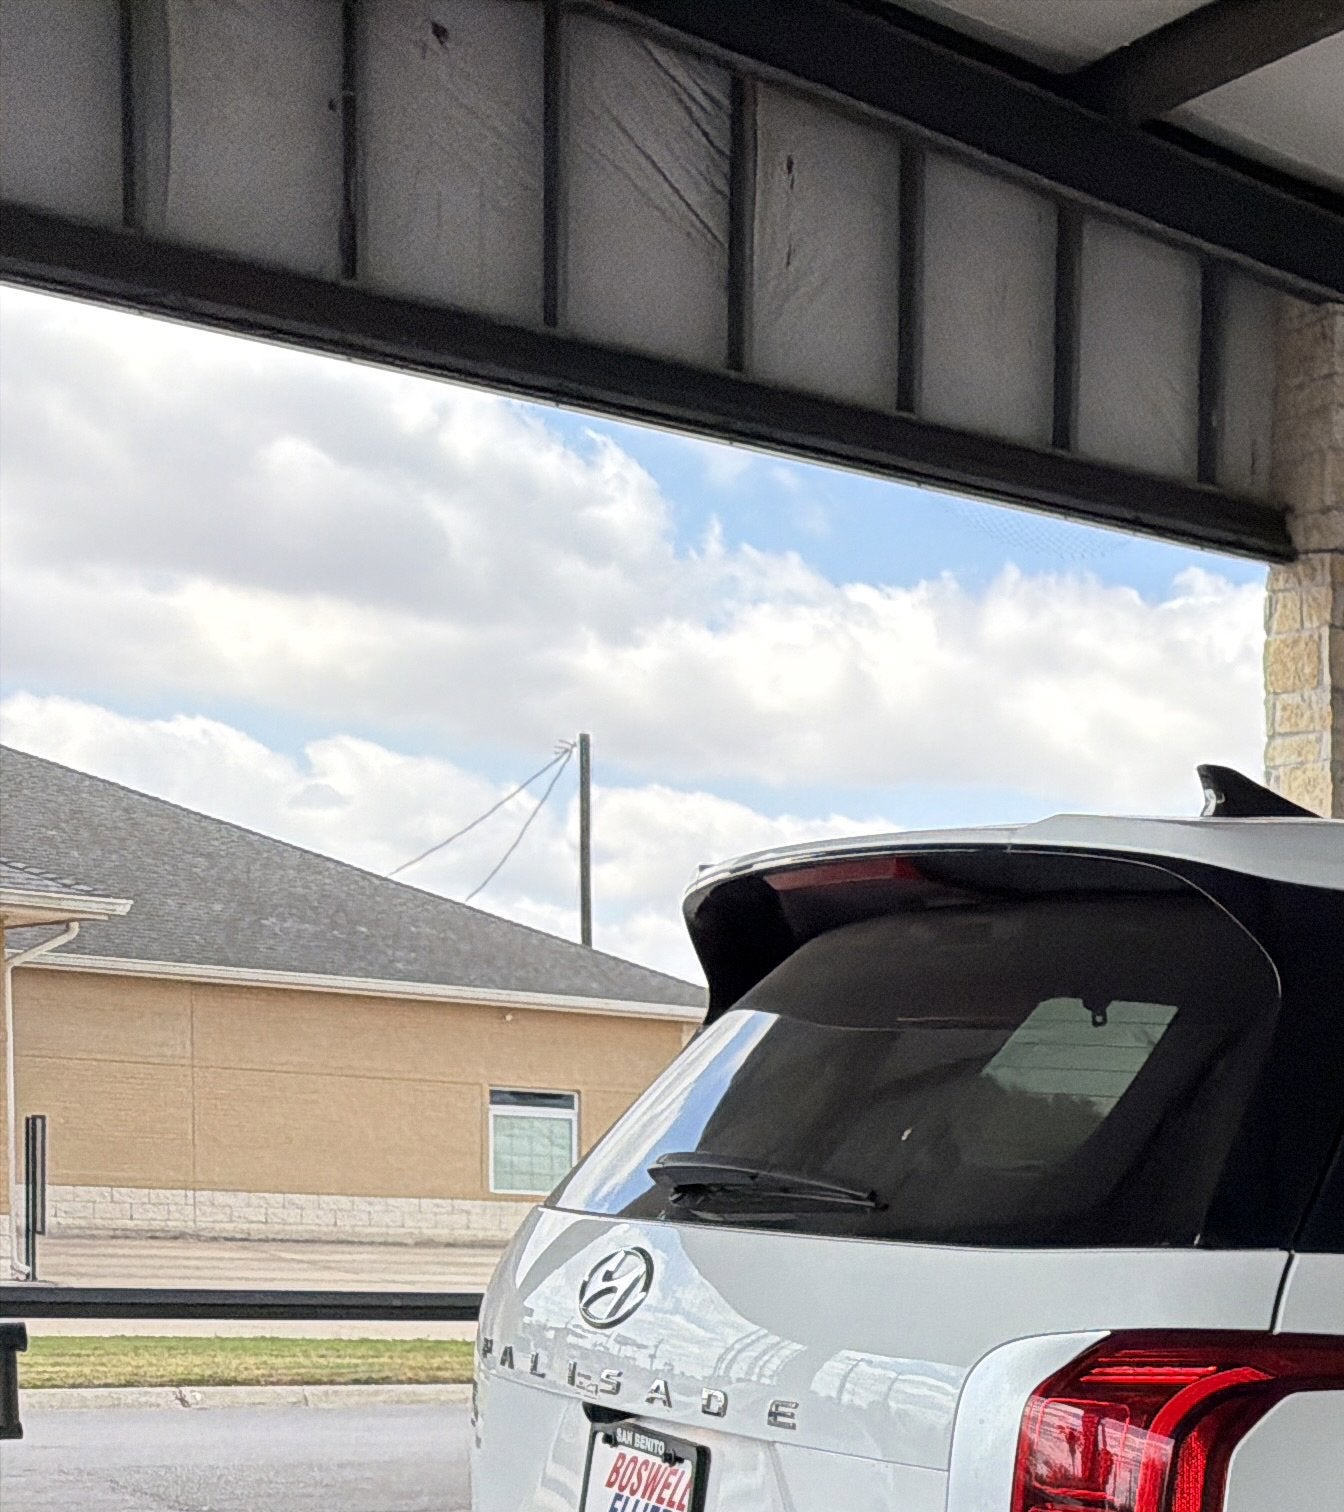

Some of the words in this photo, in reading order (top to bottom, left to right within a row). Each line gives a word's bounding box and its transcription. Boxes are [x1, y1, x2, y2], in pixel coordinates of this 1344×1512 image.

[481, 1337, 800, 1431] PALISADE
[616, 1427, 633, 1446] SAN
[633, 1432, 666, 1456] BENITO
[605, 1451, 693, 1512] BOSWELL
